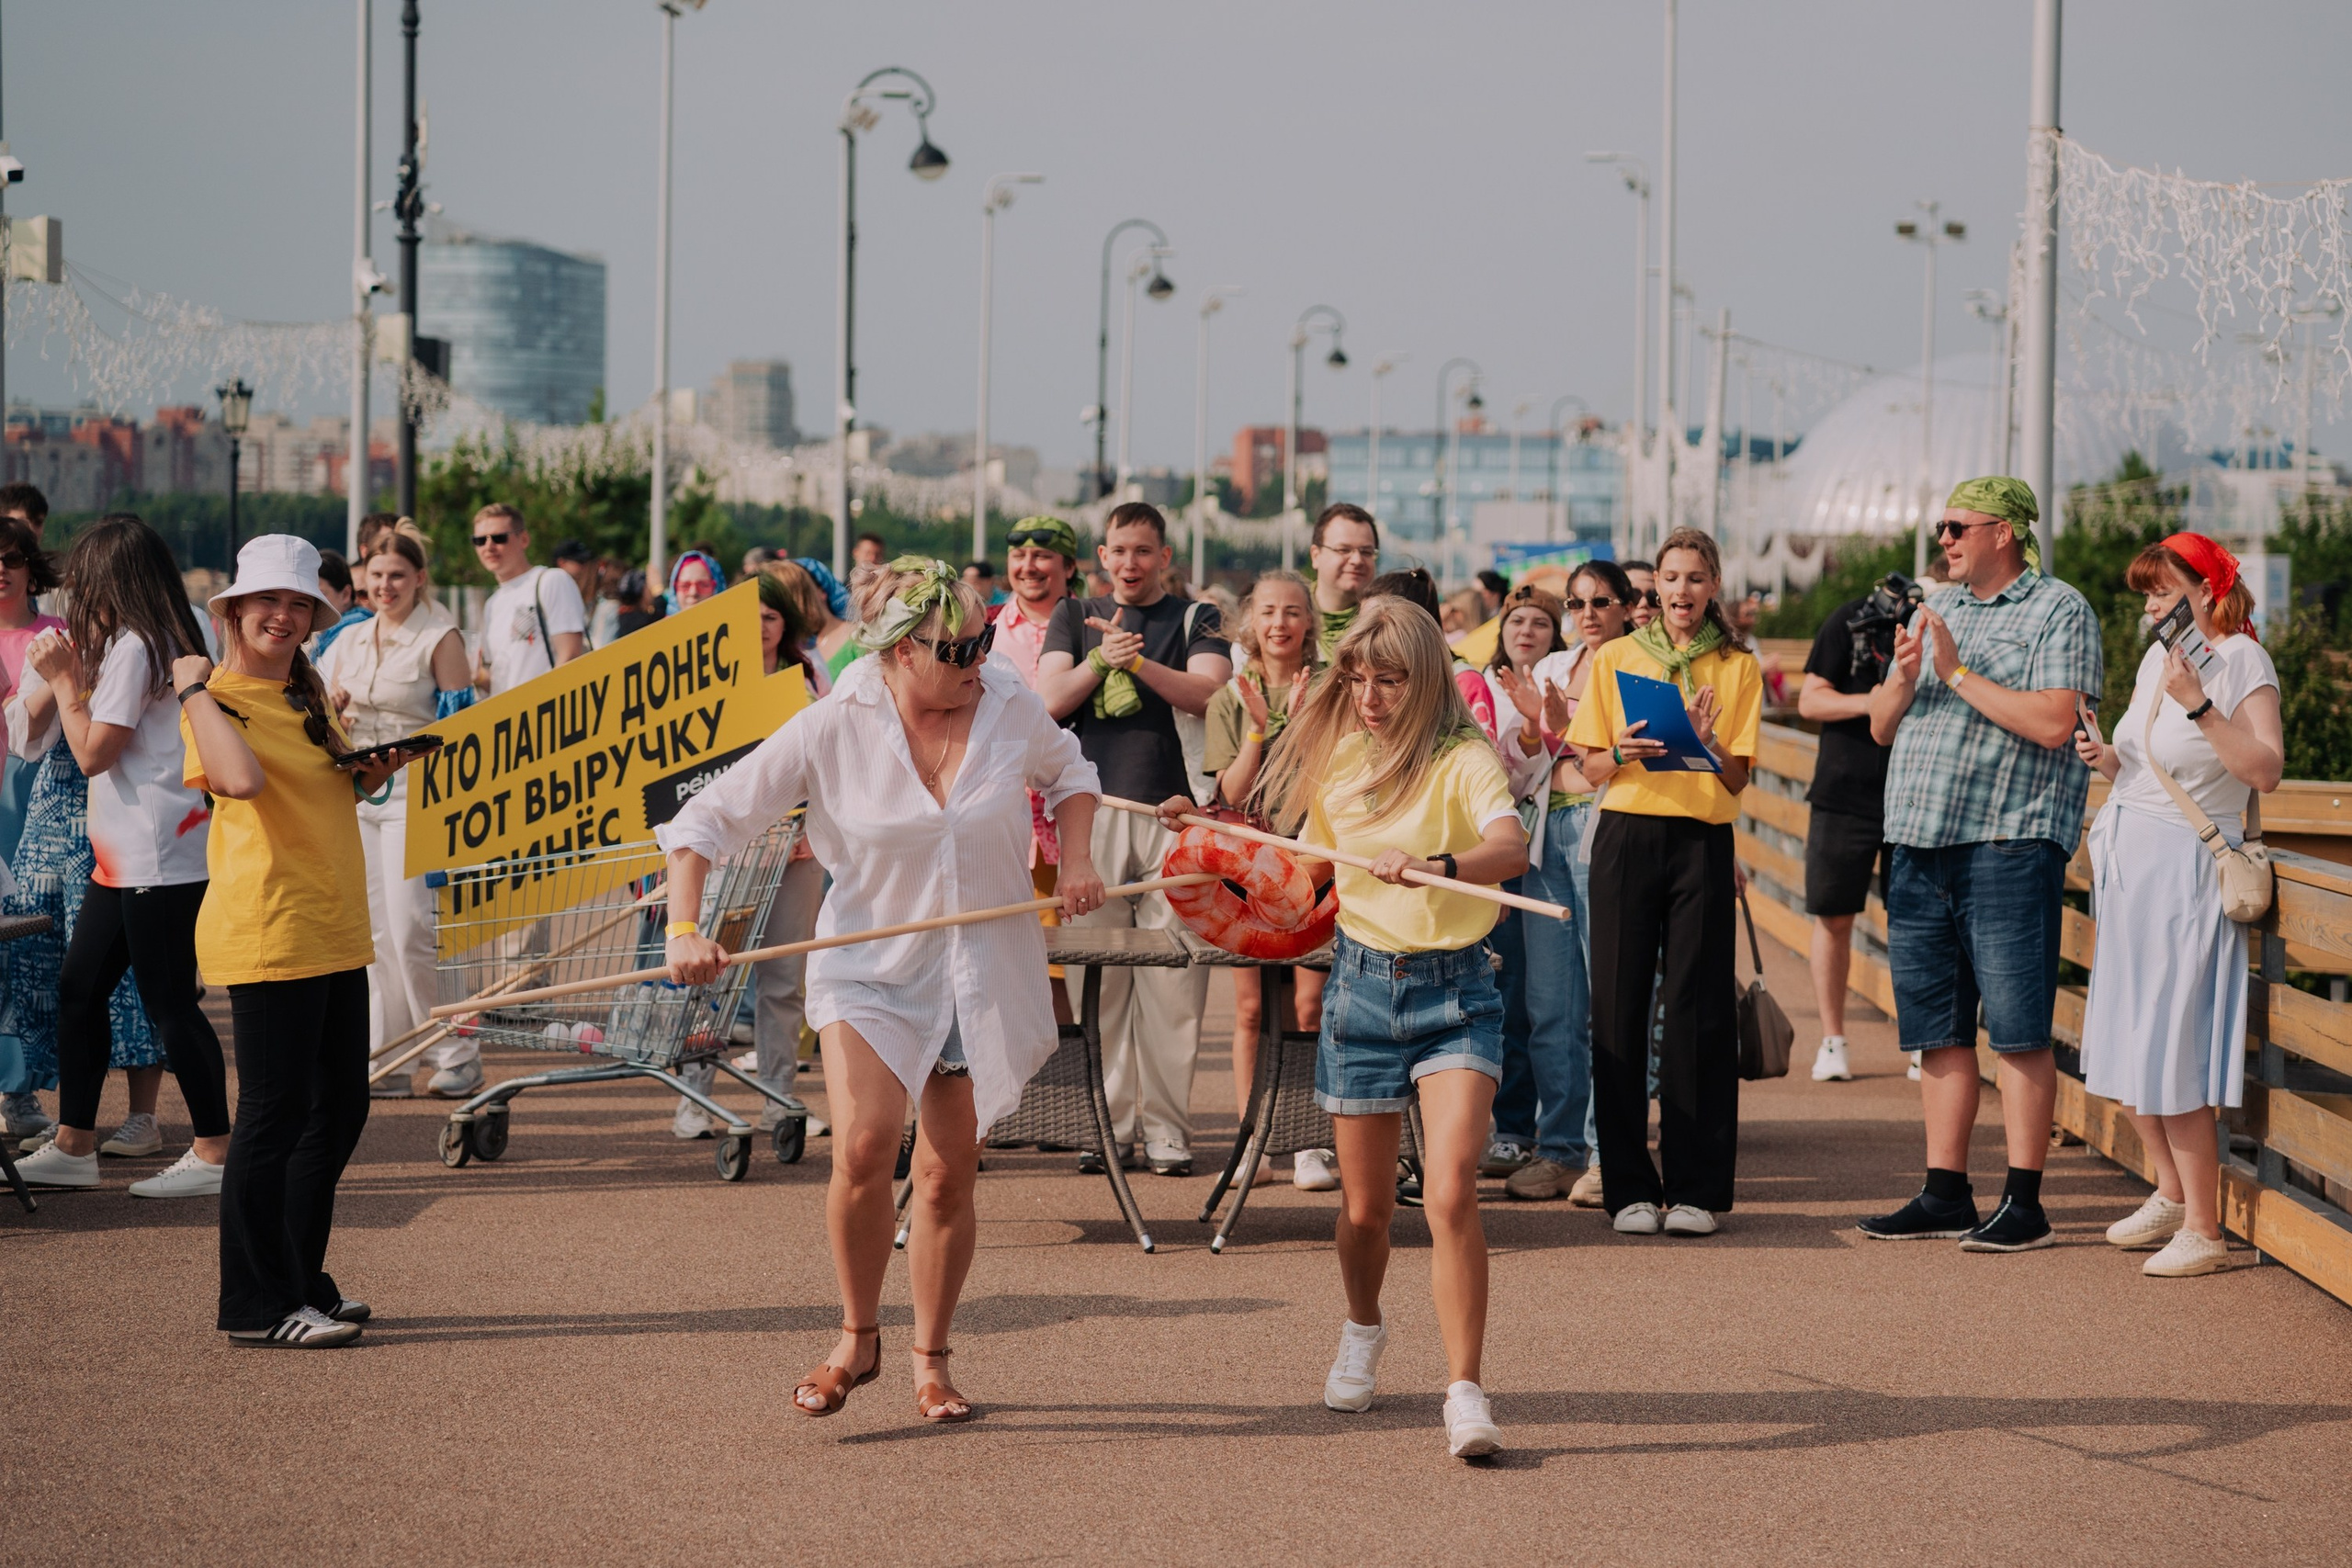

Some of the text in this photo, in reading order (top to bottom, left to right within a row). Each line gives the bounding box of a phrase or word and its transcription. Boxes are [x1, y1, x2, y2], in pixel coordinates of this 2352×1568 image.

[422, 623, 740, 809] КТО ЛАПШУ ДОНЕС,
[444, 698, 726, 858] ТОТ ВЫРУЧКУ
[454, 805, 622, 916] ПРИНЁС
